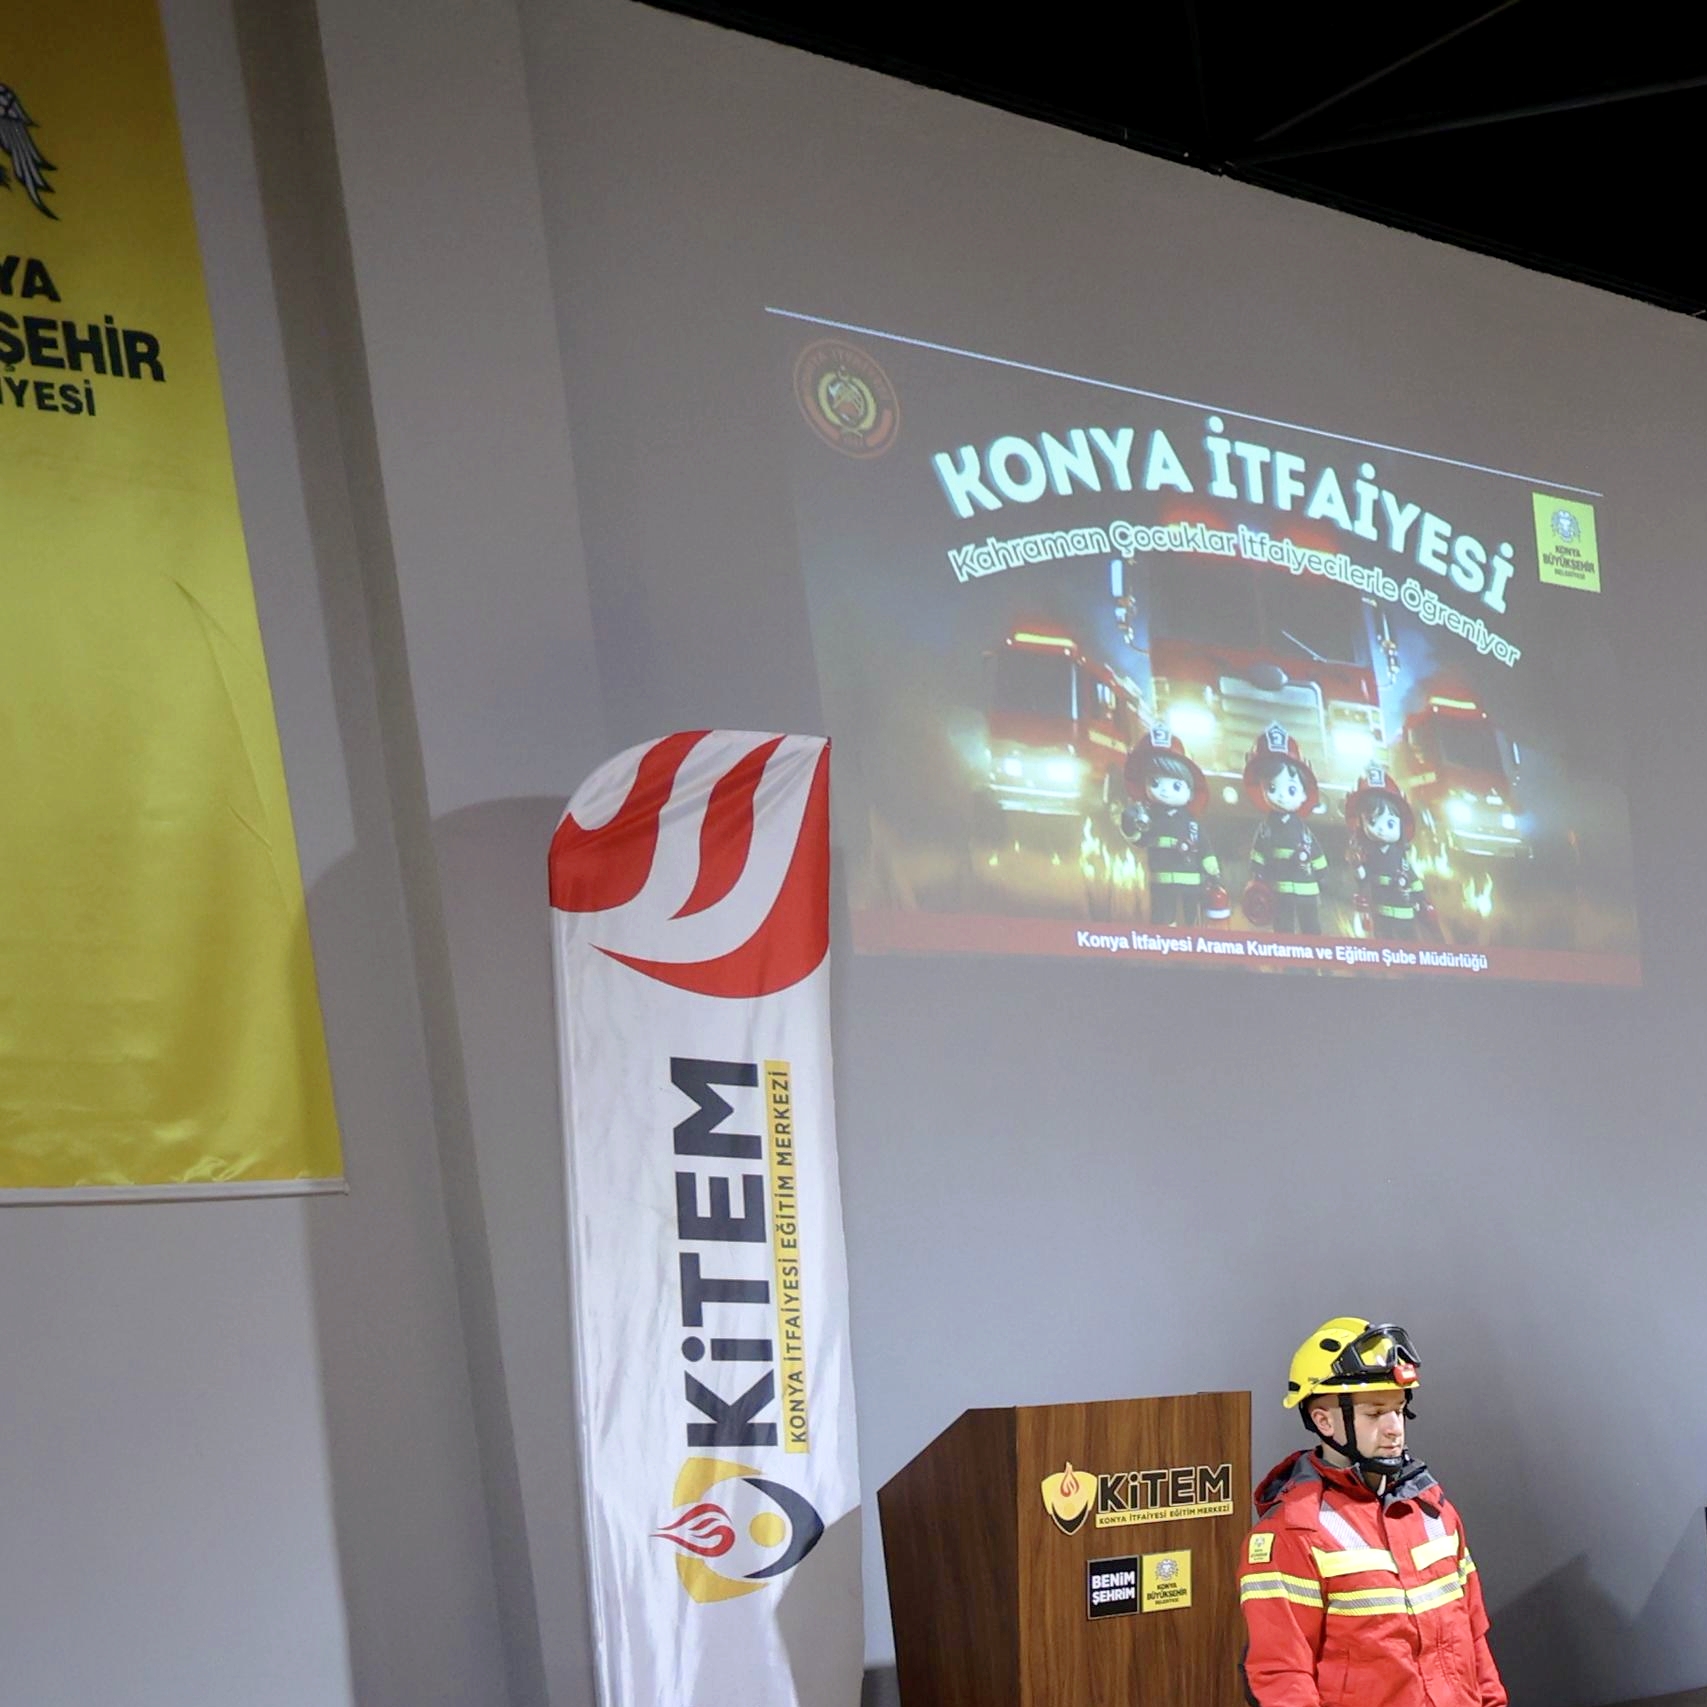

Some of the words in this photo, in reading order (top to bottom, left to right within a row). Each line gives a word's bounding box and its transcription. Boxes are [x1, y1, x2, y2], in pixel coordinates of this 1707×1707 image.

[932, 427, 1195, 519] KONYA
[1205, 415, 1515, 614] İTFAİYESİ
[947, 526, 1111, 584] Kahraman
[1109, 520, 1237, 558] Çocuklar
[1238, 524, 1400, 603] İtfaiyecilerle
[1400, 578, 1522, 668] Öğreniyor
[1076, 930, 1129, 953] Konya
[1131, 930, 1193, 955] İtfaiyesi
[1196, 936, 1244, 956] Arama
[1246, 940, 1313, 959] Kurtarma
[1315, 948, 1333, 960] ve
[1335, 945, 1380, 965] Eğitim
[1381, 949, 1417, 967] Şube
[1418, 950, 1489, 972] Müdürlüğü
[767, 1070, 793, 1167] MERKEZİ
[773, 1175, 797, 1250] EĞİTİM
[778, 1257, 802, 1362] İTFAİYESİ
[787, 1369, 807, 1443] KONYA
[1098, 1515, 1127, 1525] KONYA
[1128, 1511, 1167, 1523] İTFAİYESİ
[1169, 1507, 1195, 1518] EĞİTİM
[1196, 1503, 1231, 1516] MERKEZİ
